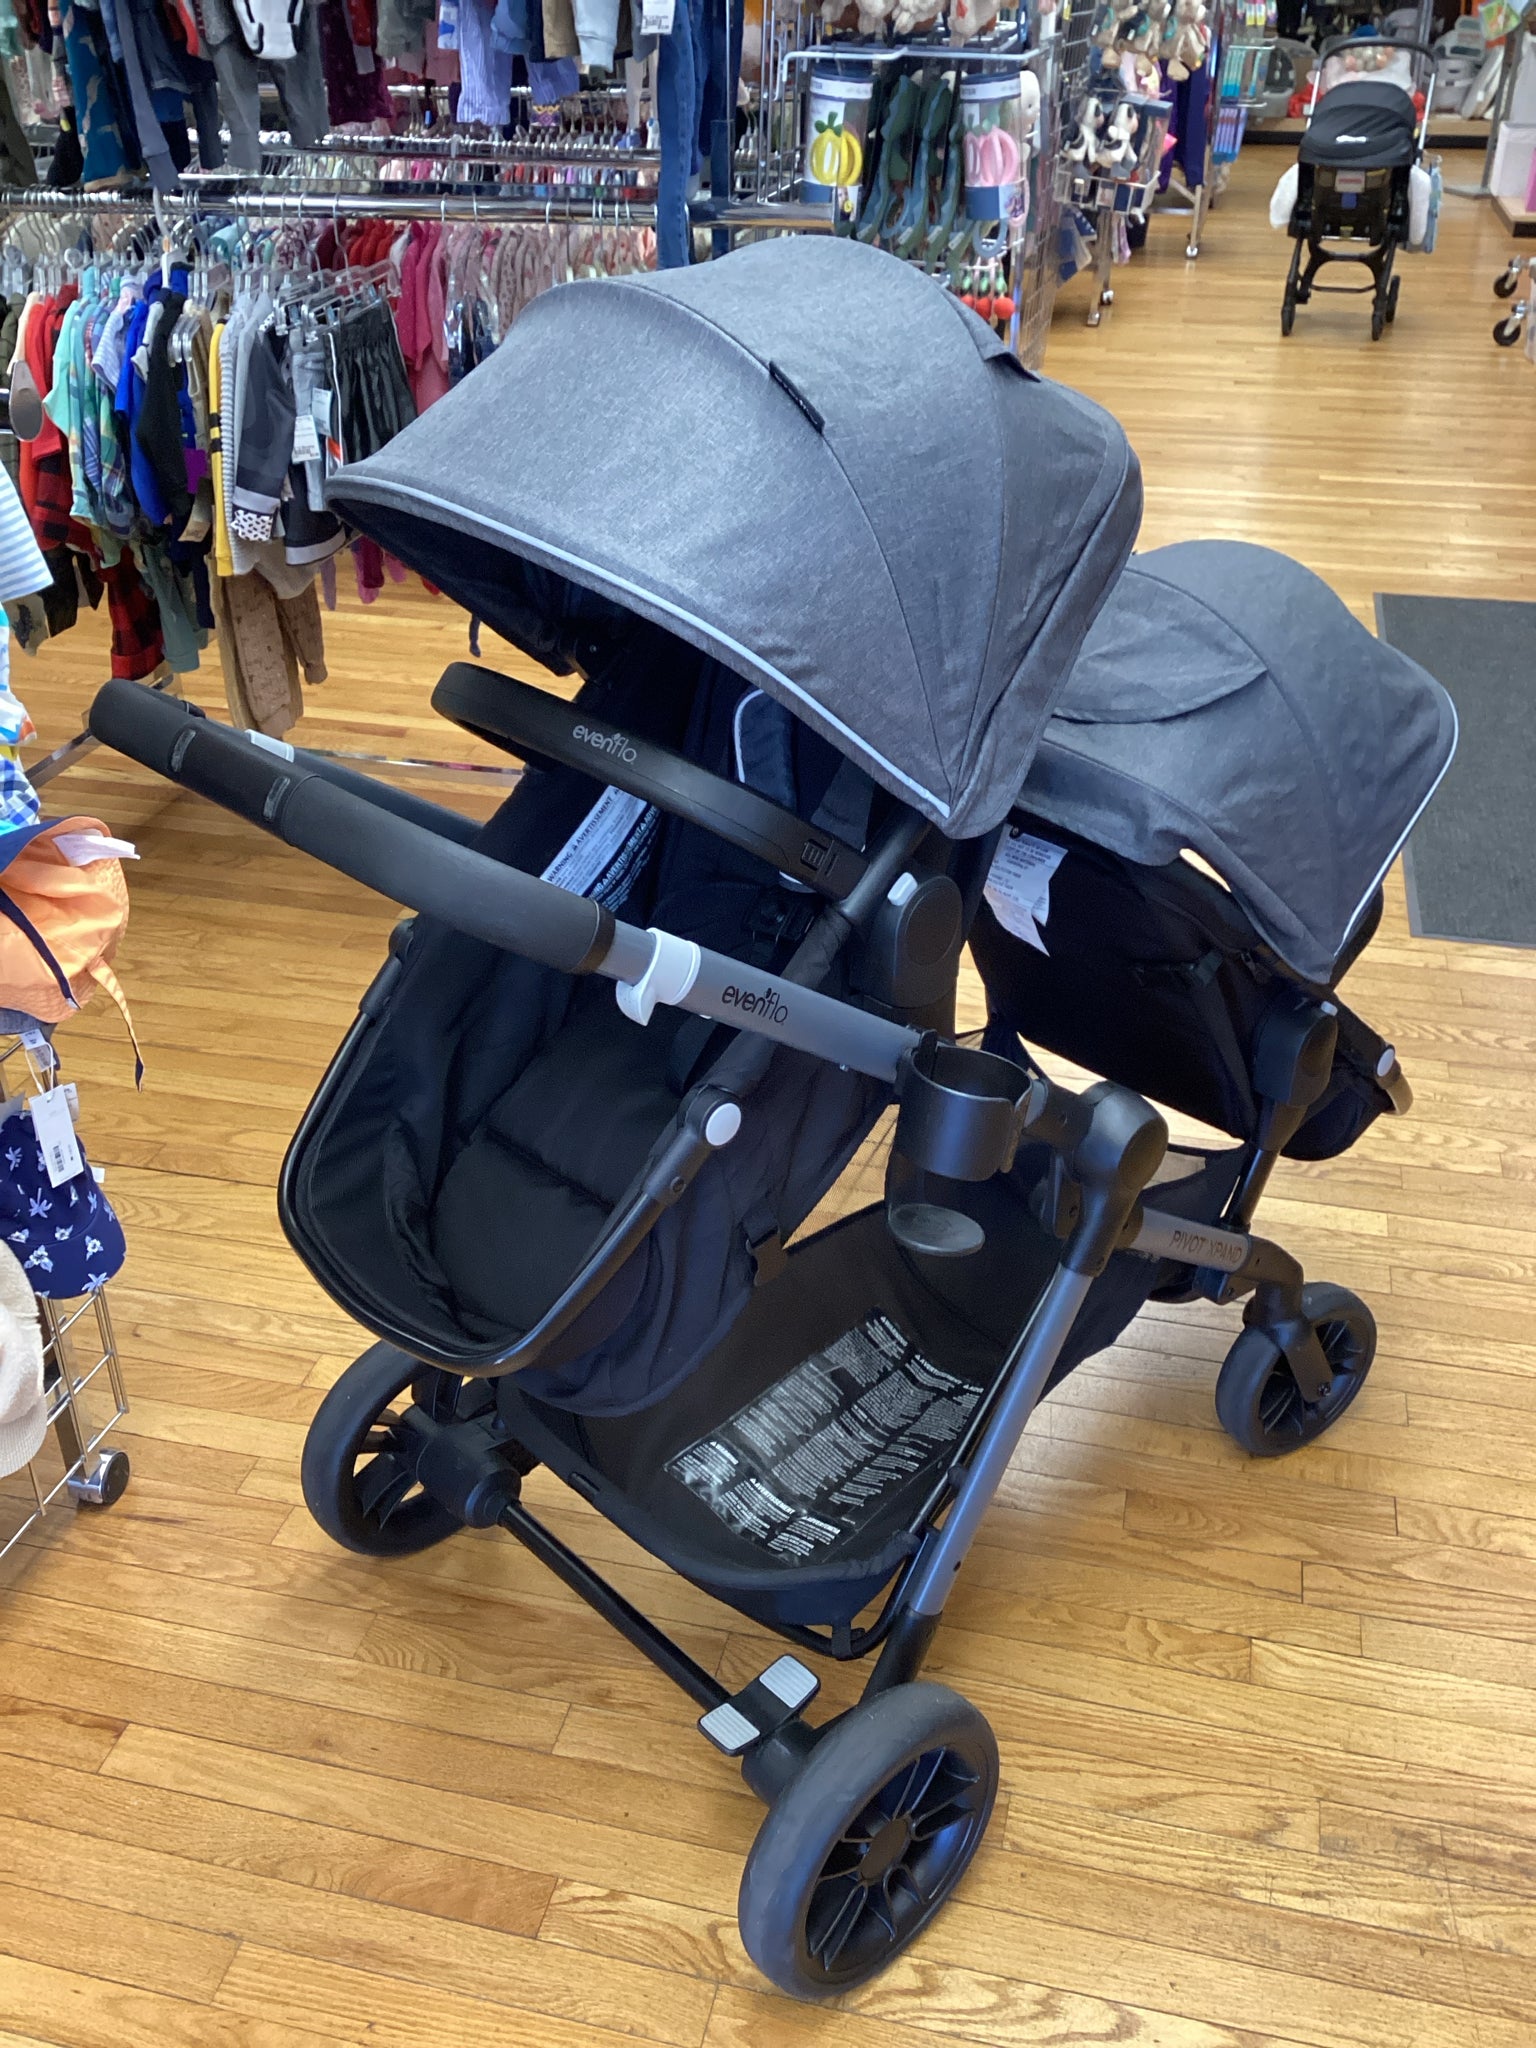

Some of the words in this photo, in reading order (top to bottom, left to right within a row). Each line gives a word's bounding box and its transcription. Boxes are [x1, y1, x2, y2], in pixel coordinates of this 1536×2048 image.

[573, 725, 637, 763] evenflo
[547, 852, 573, 882] WARNING
[575, 796, 614, 846] AVERTISSEMENT
[722, 986, 788, 1023] evenflo
[1169, 1230, 1207, 1254] PIVOT
[1207, 1238, 1242, 1263] XPAND
